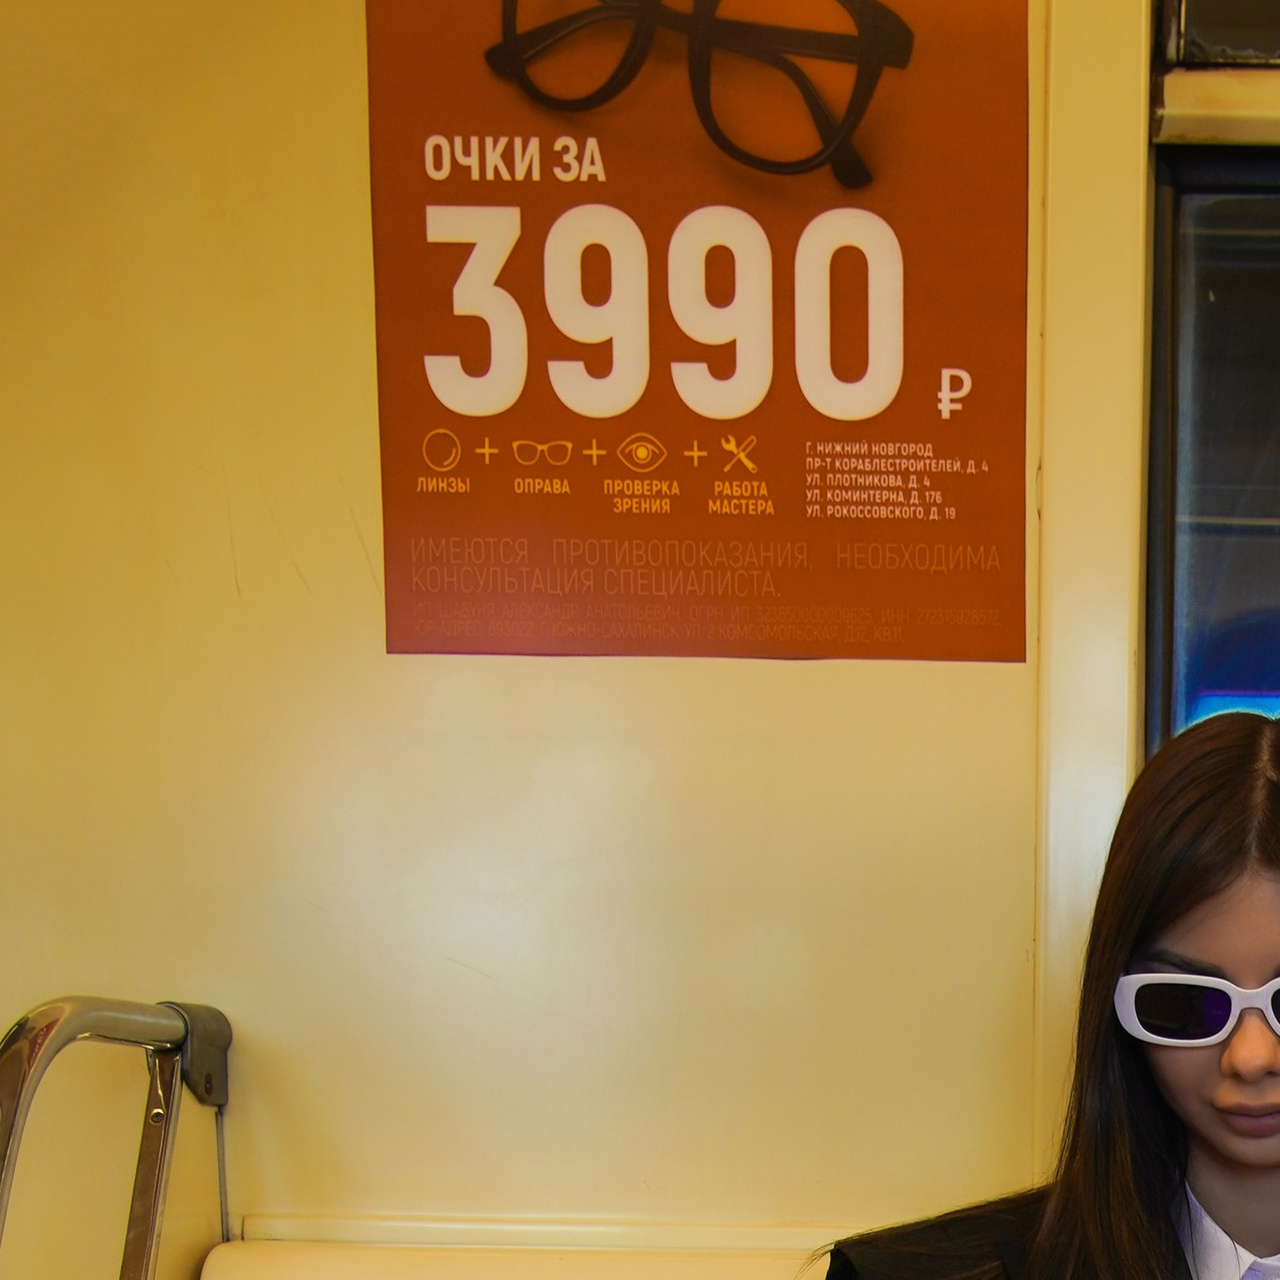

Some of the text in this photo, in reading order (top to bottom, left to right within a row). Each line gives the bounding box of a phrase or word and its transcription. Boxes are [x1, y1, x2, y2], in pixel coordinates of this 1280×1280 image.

[424, 134, 607, 182] ОЧКИ ЗА
[423, 203, 904, 421] 3990
[805, 440, 934, 458] Г. НИЖНИЙ НОВГОРОД
[805, 457, 989, 474] ПР-Т КОРАБЛЕСТРОИТЕЛЕЙ, Д. 4
[416, 476, 471, 493] ЛИНЗЫ
[514, 478, 571, 494] ОПРАВА
[603, 479, 681, 496] ПРОВЕРКА
[714, 480, 769, 497] РАБОТА
[805, 473, 931, 489] УЛ. ПЛОТНИКОВА, Д. 4
[805, 489, 943, 505] УЛ. КОМИНТЕРНА, Д. 176
[613, 498, 671, 514] ЗРЕНИЯ
[708, 499, 775, 515] МАСТЕРА
[805, 505, 956, 521] УЛ. РОКОССОВСКОГО, Д. 19
[410, 537, 1001, 573] ИМЕЮТСЯ ПРОТИВОПОКАЗАНИЯ, НЕОБХОДИМА
[411, 566, 781, 599] КОНСУЛЬТАЦИЯ СПЕЦИАЛИСТА.
